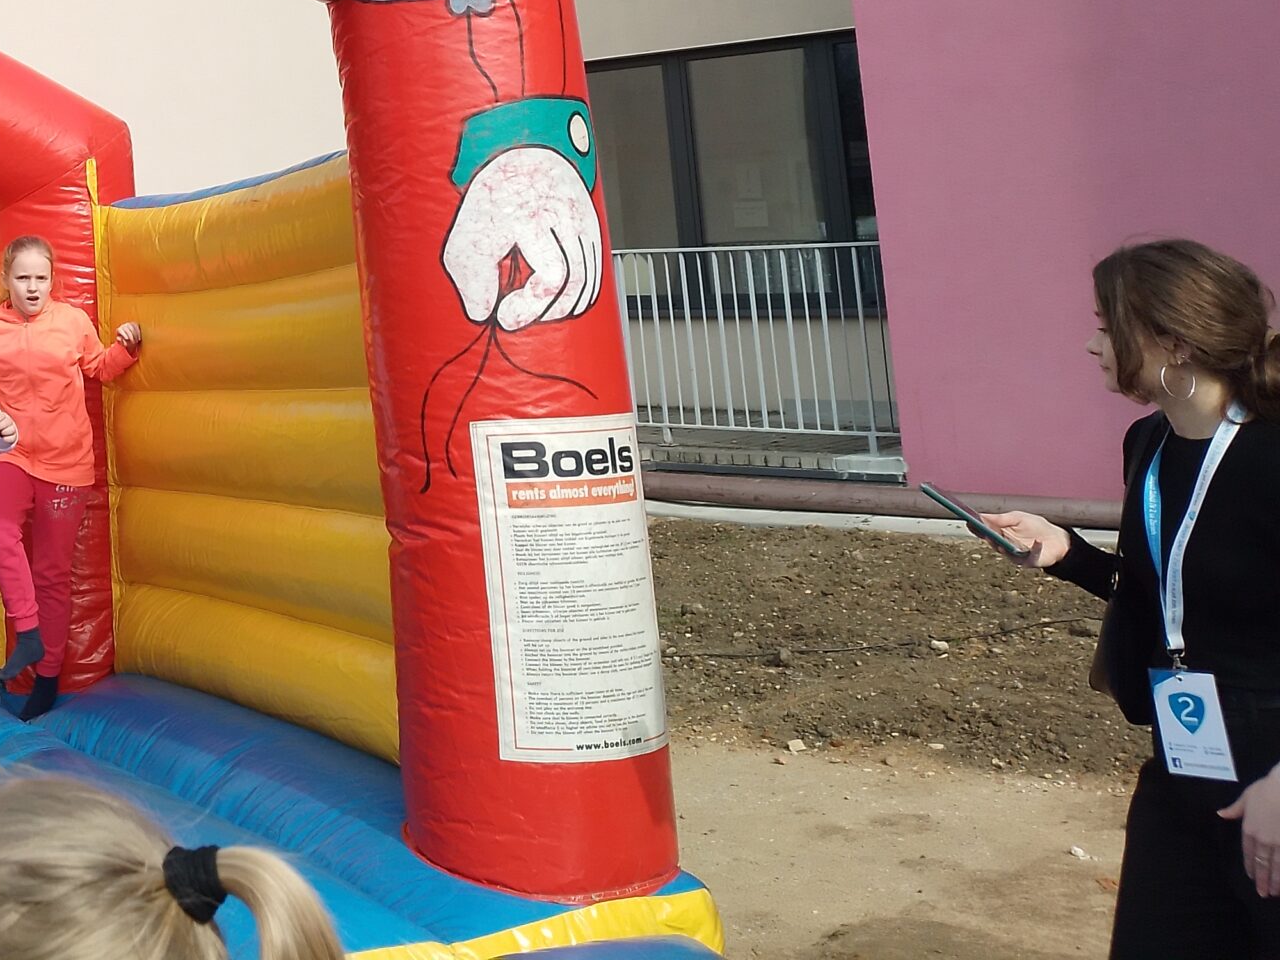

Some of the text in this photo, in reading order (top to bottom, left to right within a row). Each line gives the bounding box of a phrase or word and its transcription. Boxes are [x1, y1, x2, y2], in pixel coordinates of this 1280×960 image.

[501, 437, 634, 479] Boels
[512, 487, 546, 500] rents
[549, 484, 589, 499] almost
[1177, 696, 1199, 722] 2
[576, 737, 642, 750] www.boels.com
